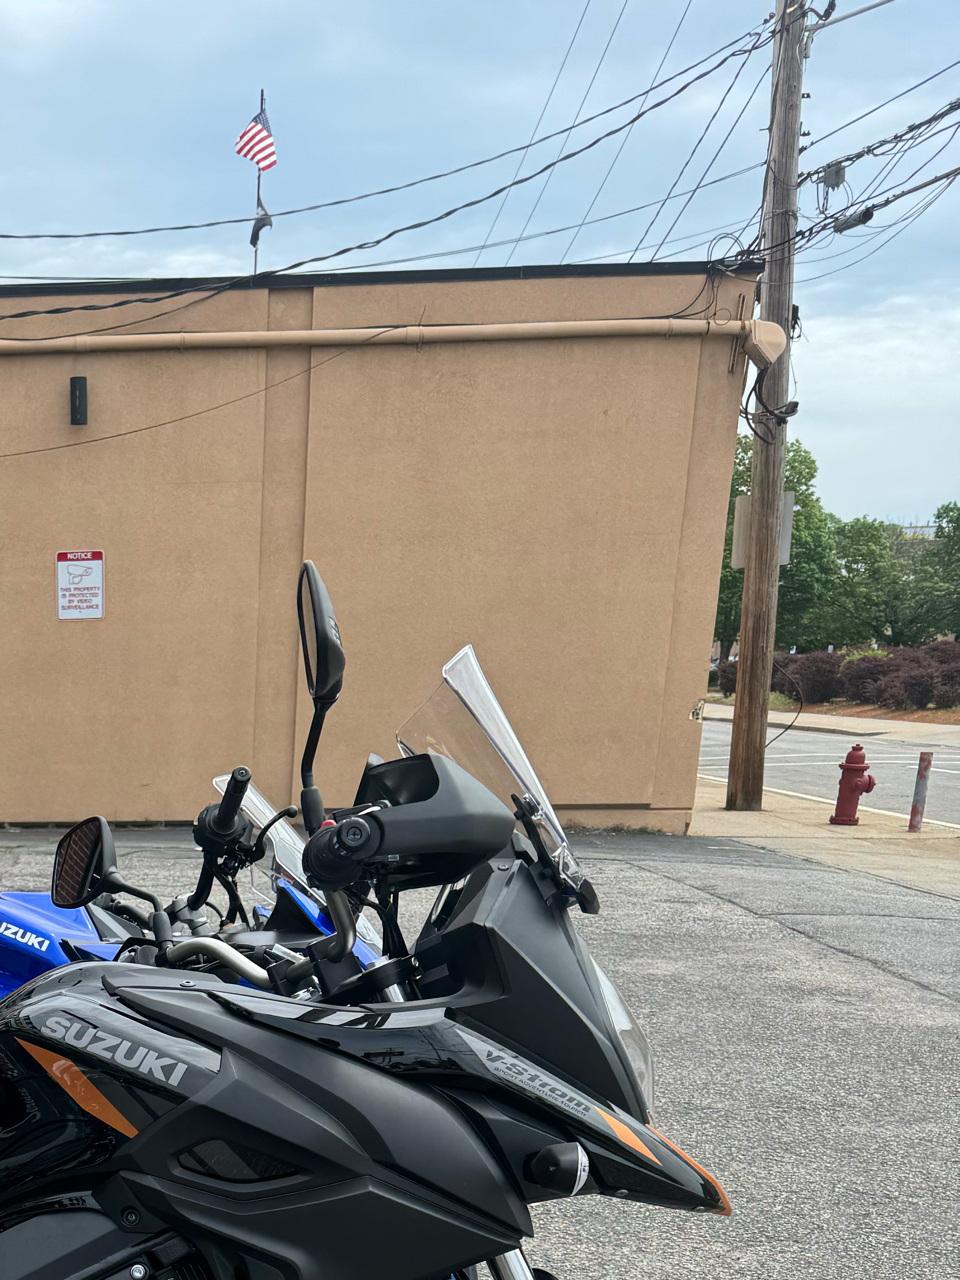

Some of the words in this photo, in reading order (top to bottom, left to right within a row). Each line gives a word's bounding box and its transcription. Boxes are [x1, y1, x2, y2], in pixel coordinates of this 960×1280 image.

[41, 1016, 188, 1087] SUZUKI
[486, 1050, 591, 1113] V-Strom
[519, 1078, 559, 1102] ADVENTURE
[560, 1100, 586, 1117] TOURER
